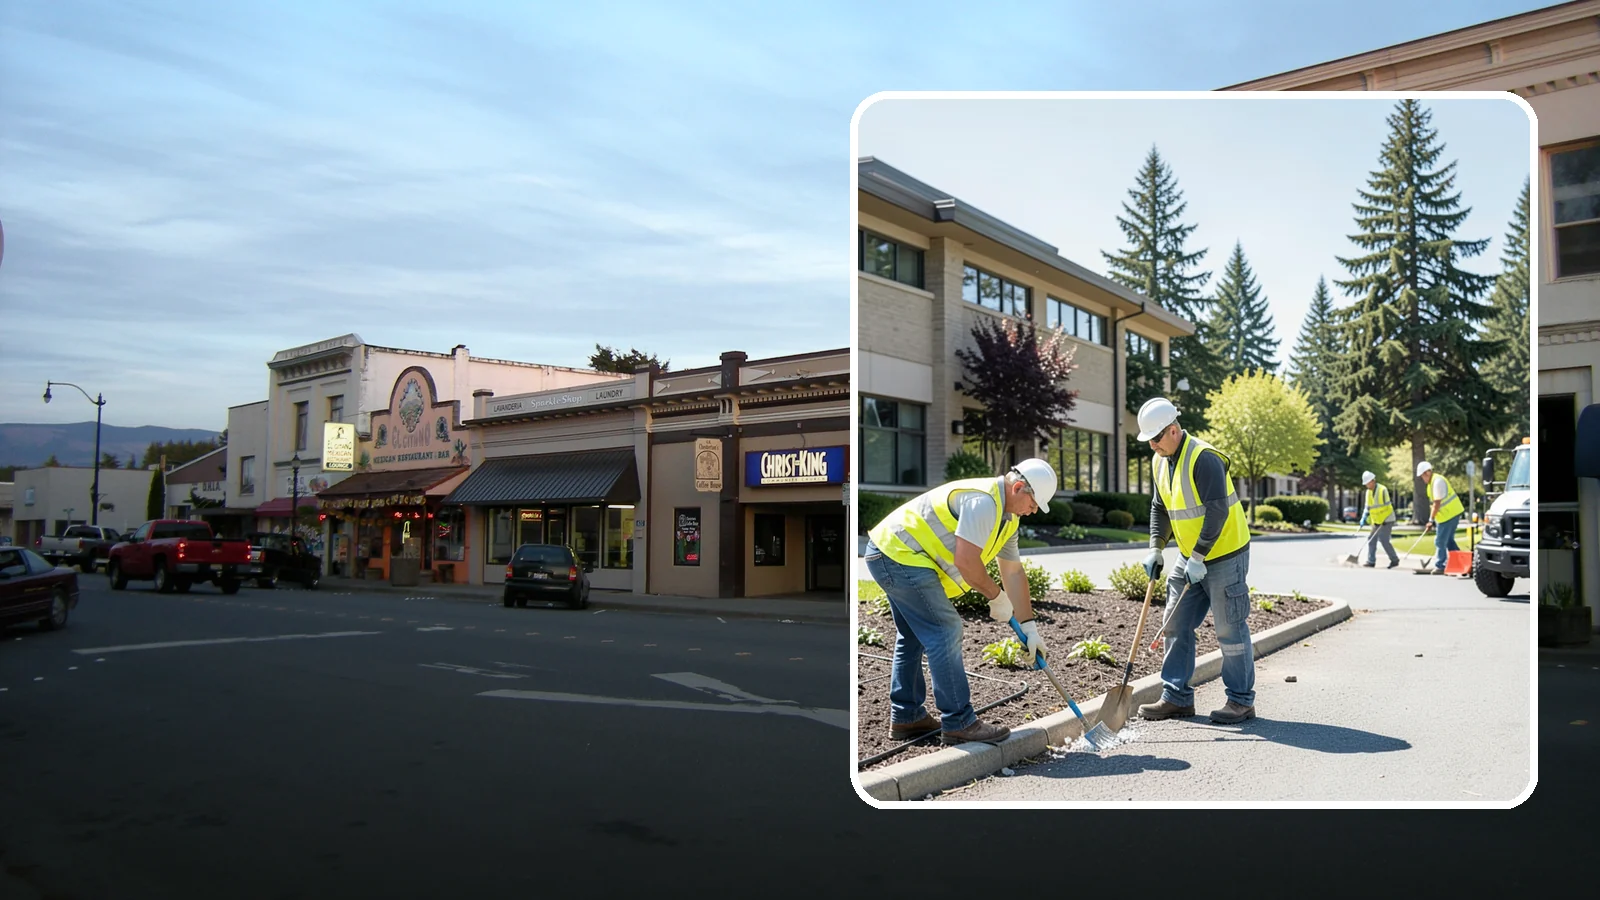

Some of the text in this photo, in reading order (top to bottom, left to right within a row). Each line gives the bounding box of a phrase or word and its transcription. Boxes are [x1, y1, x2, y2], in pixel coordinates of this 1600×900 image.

[595, 389, 623, 400] LAUNDRY
[493, 402, 522, 412] LAVANDERIA
[531, 395, 582, 409] Sparkle Shop
[373, 455, 396, 464] MEXICAN
[397, 451, 433, 462] RESTAURANT
[438, 450, 450, 459] BAR
[761, 450, 827, 477] CHRIST KING
